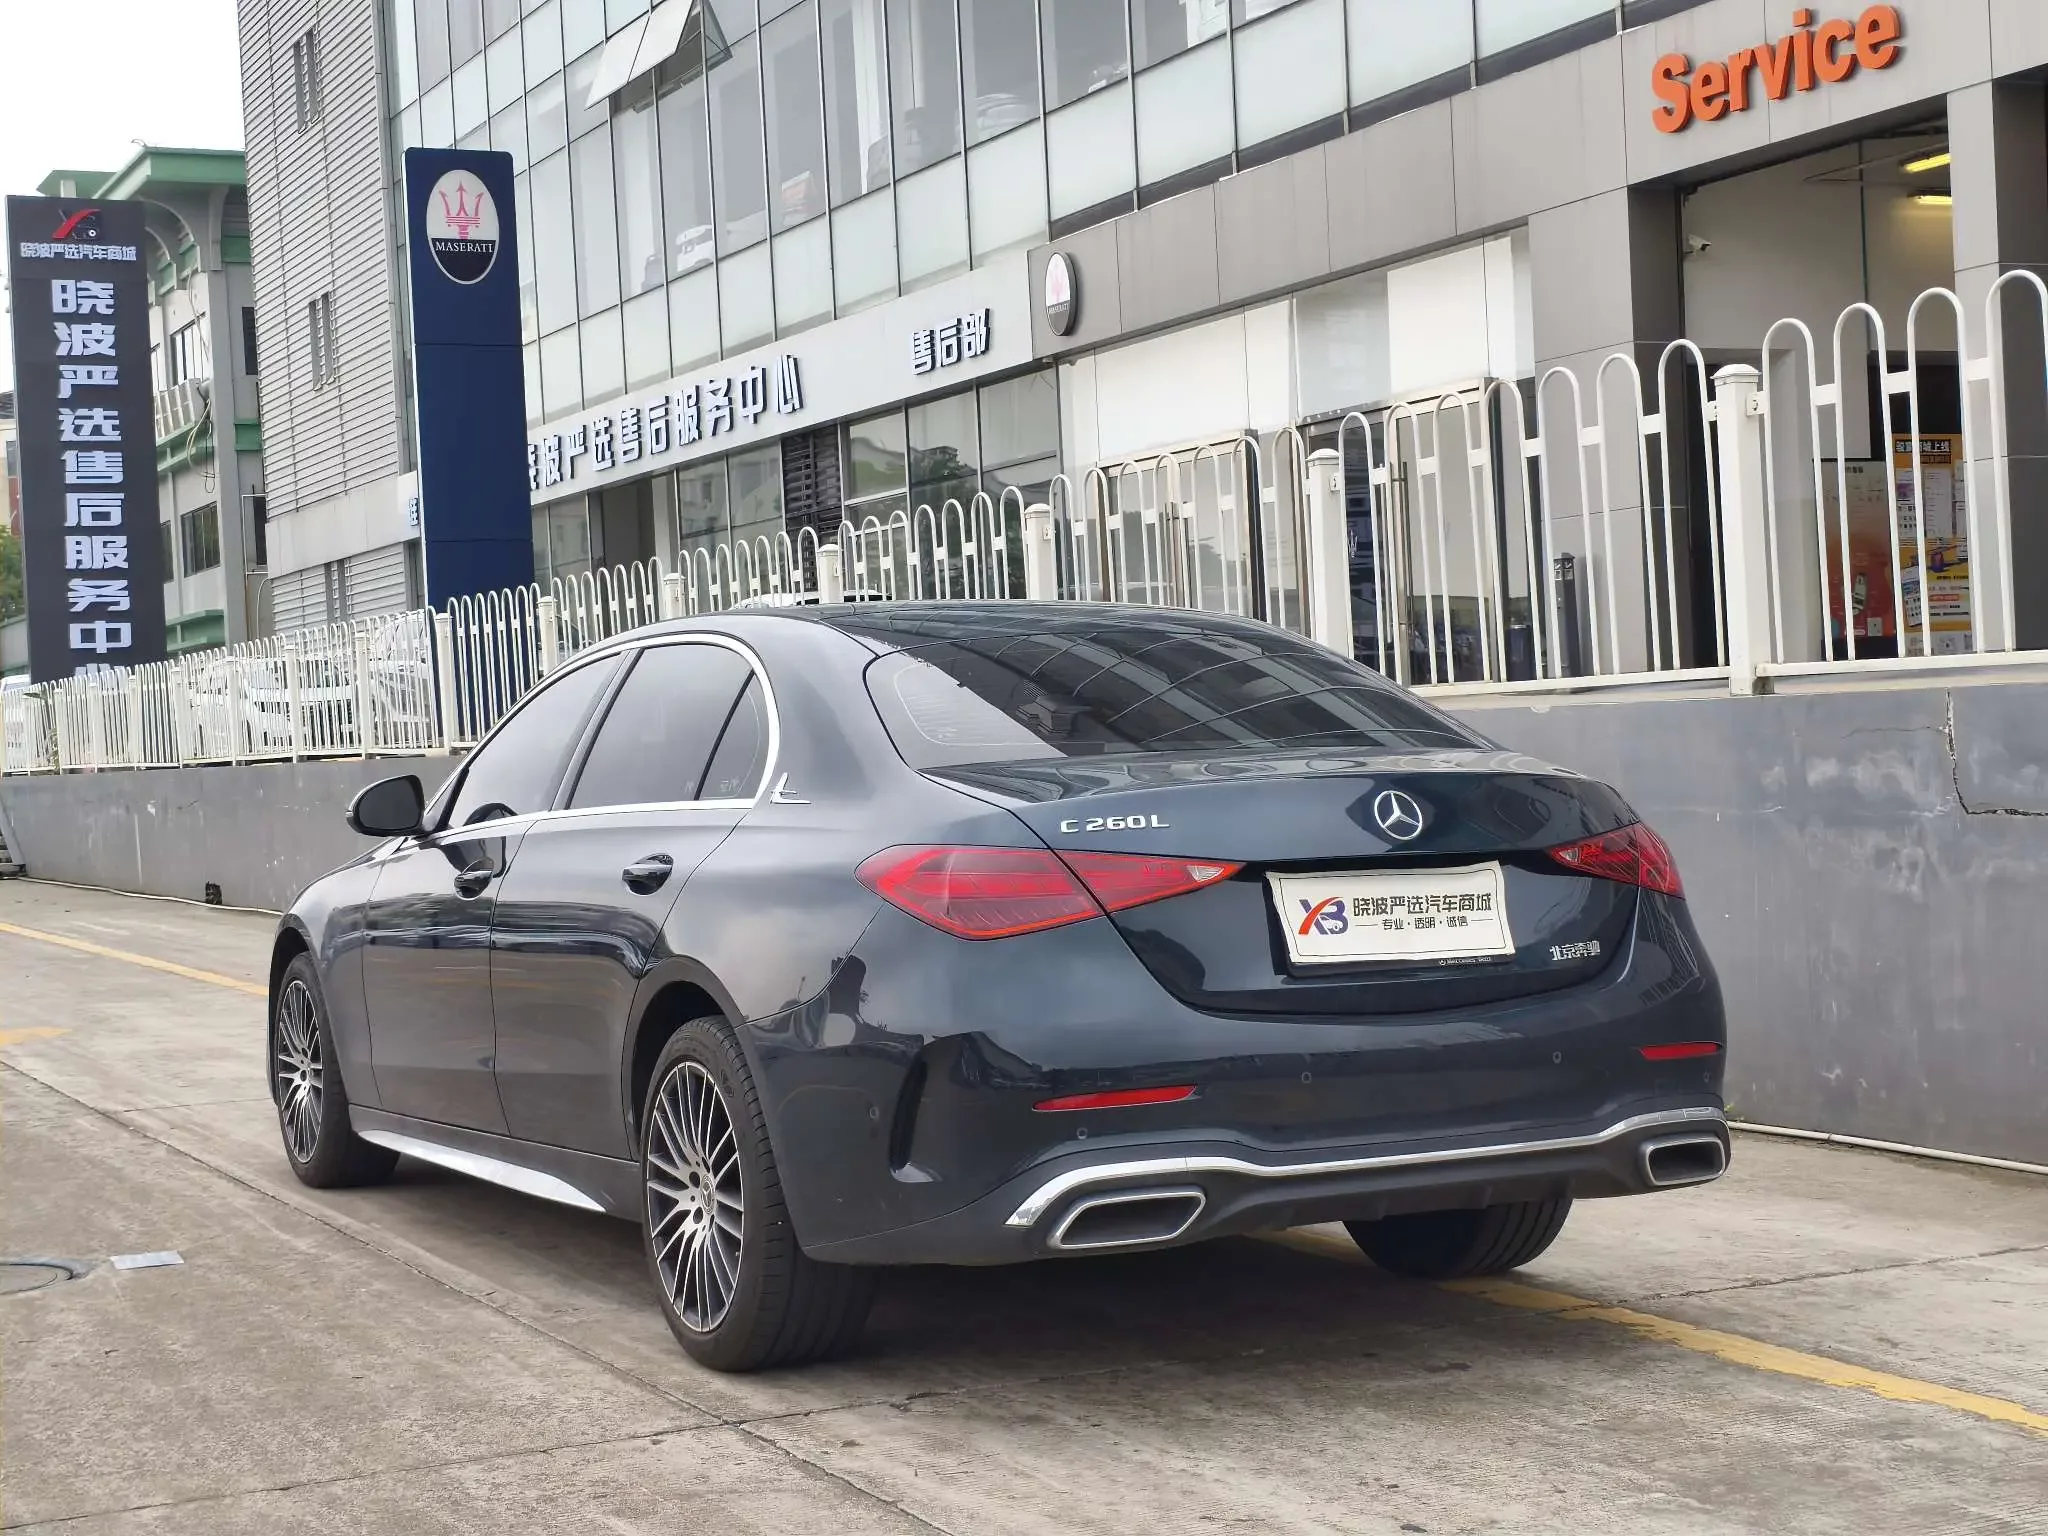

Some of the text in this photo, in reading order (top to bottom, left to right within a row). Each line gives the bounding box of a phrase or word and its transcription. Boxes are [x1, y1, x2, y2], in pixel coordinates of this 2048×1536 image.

[1652, 4, 1902, 133] Service
[20, 242, 137, 261] 晓波严选汽车商城
[435, 241, 494, 253] MASERATI
[911, 308, 990, 375] 售后部
[1060, 819, 1080, 833] C
[1353, 893, 1491, 917] 晓波严选汽车商城
